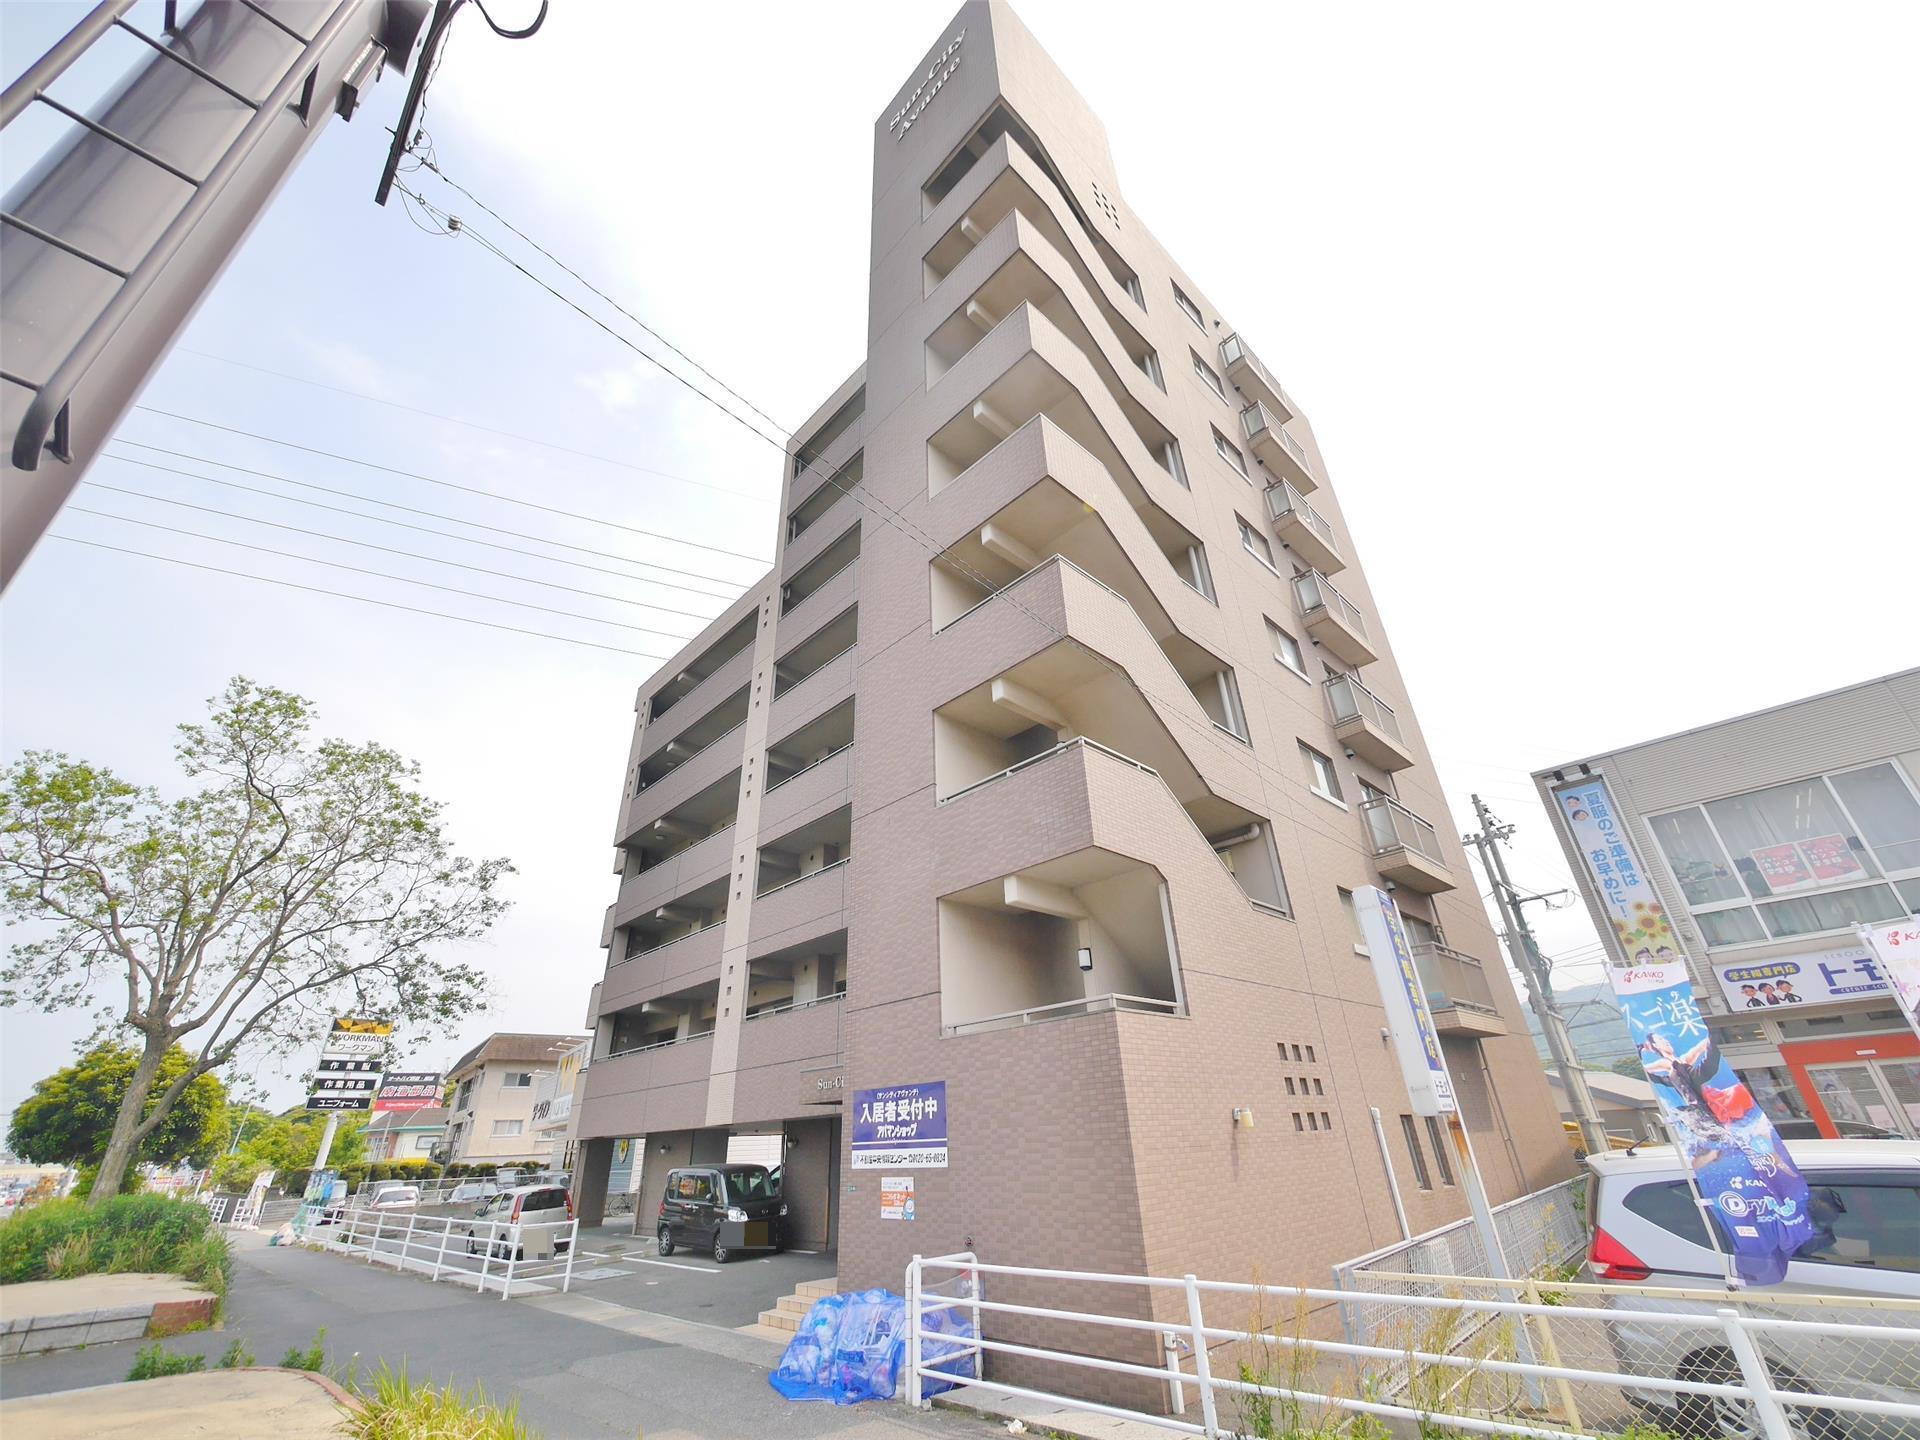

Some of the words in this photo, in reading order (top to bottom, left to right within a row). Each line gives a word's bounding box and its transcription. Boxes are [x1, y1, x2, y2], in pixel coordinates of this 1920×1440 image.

[890, 27, 967, 132] Sun-City
[1817, 958, 1884, 987] トモ
[338, 1043, 375, 1052] ワークマン
[324, 1080, 366, 1089] 作業用品
[317, 1099, 360, 1108] ユニフォーム
[860, 1096, 938, 1124] 入居者受付中
[877, 1122, 918, 1139] アパマンショップ
